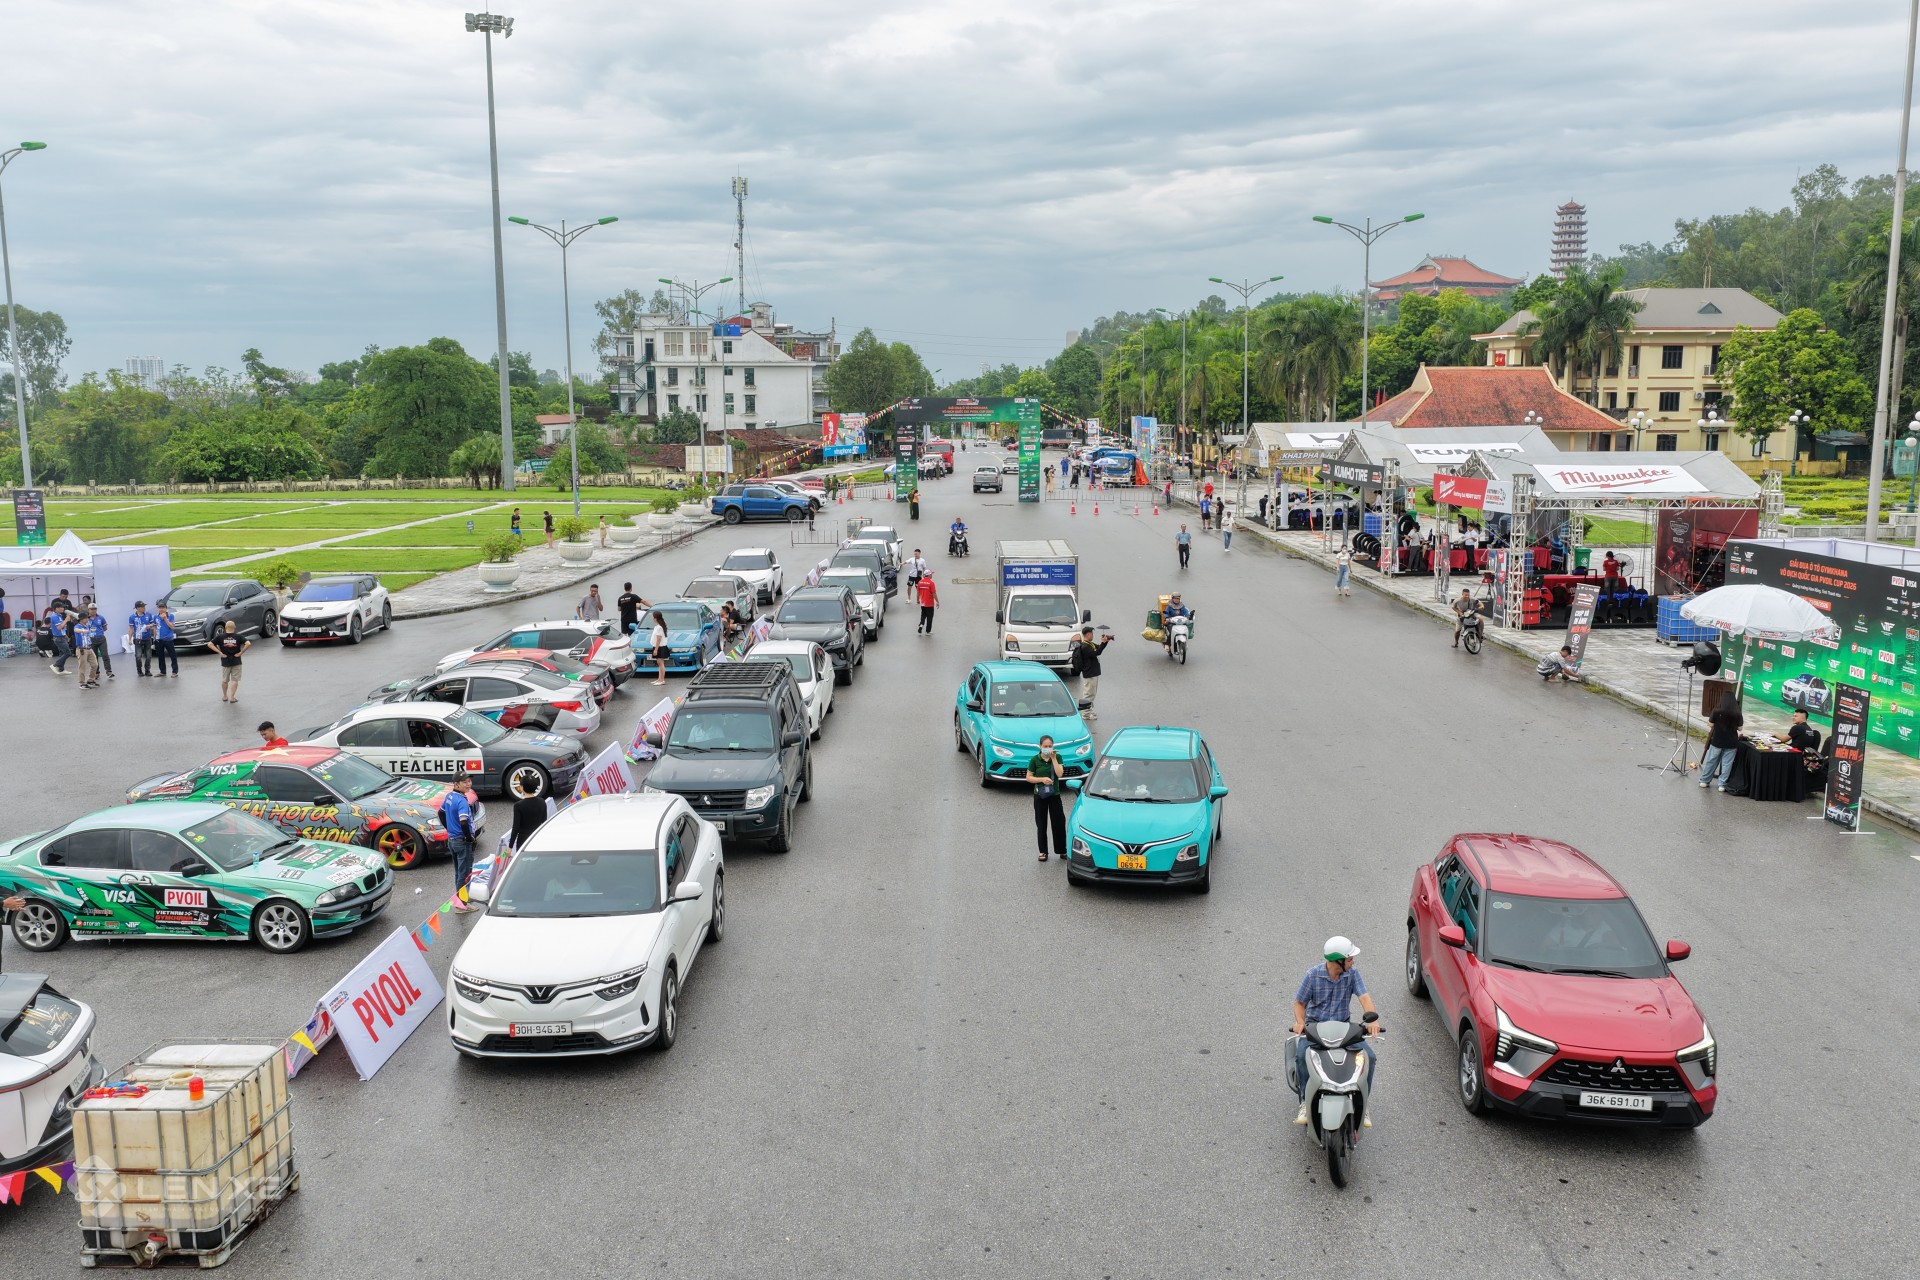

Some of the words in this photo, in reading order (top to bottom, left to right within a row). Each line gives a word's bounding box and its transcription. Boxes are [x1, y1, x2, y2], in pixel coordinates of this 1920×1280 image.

[1334, 465, 1354, 480] KUMHO
[1354, 468, 1368, 482] TIRE
[1552, 468, 1672, 485] Milwaukee
[1834, 579, 1843, 587] CUP
[1906, 580, 1917, 588] VISA
[1715, 620, 1732, 630] PVOIL
[1880, 651, 1894, 663] PVOIL
[1850, 666, 1864, 678] PVOIL
[1838, 735, 1845, 745] IN
[210, 764, 238, 775] VISA
[389, 760, 466, 772] TEACHER
[596, 761, 626, 794] PVOIL
[268, 801, 340, 826] MOTOR
[302, 825, 358, 844] SHOW
[102, 890, 136, 904] VISA
[167, 891, 204, 906] PVOIL
[352, 961, 422, 1044] PVOIL
[516, 1025, 566, 1034] 30H-946.35
[1587, 1095, 1645, 1107] 36K-691.01
